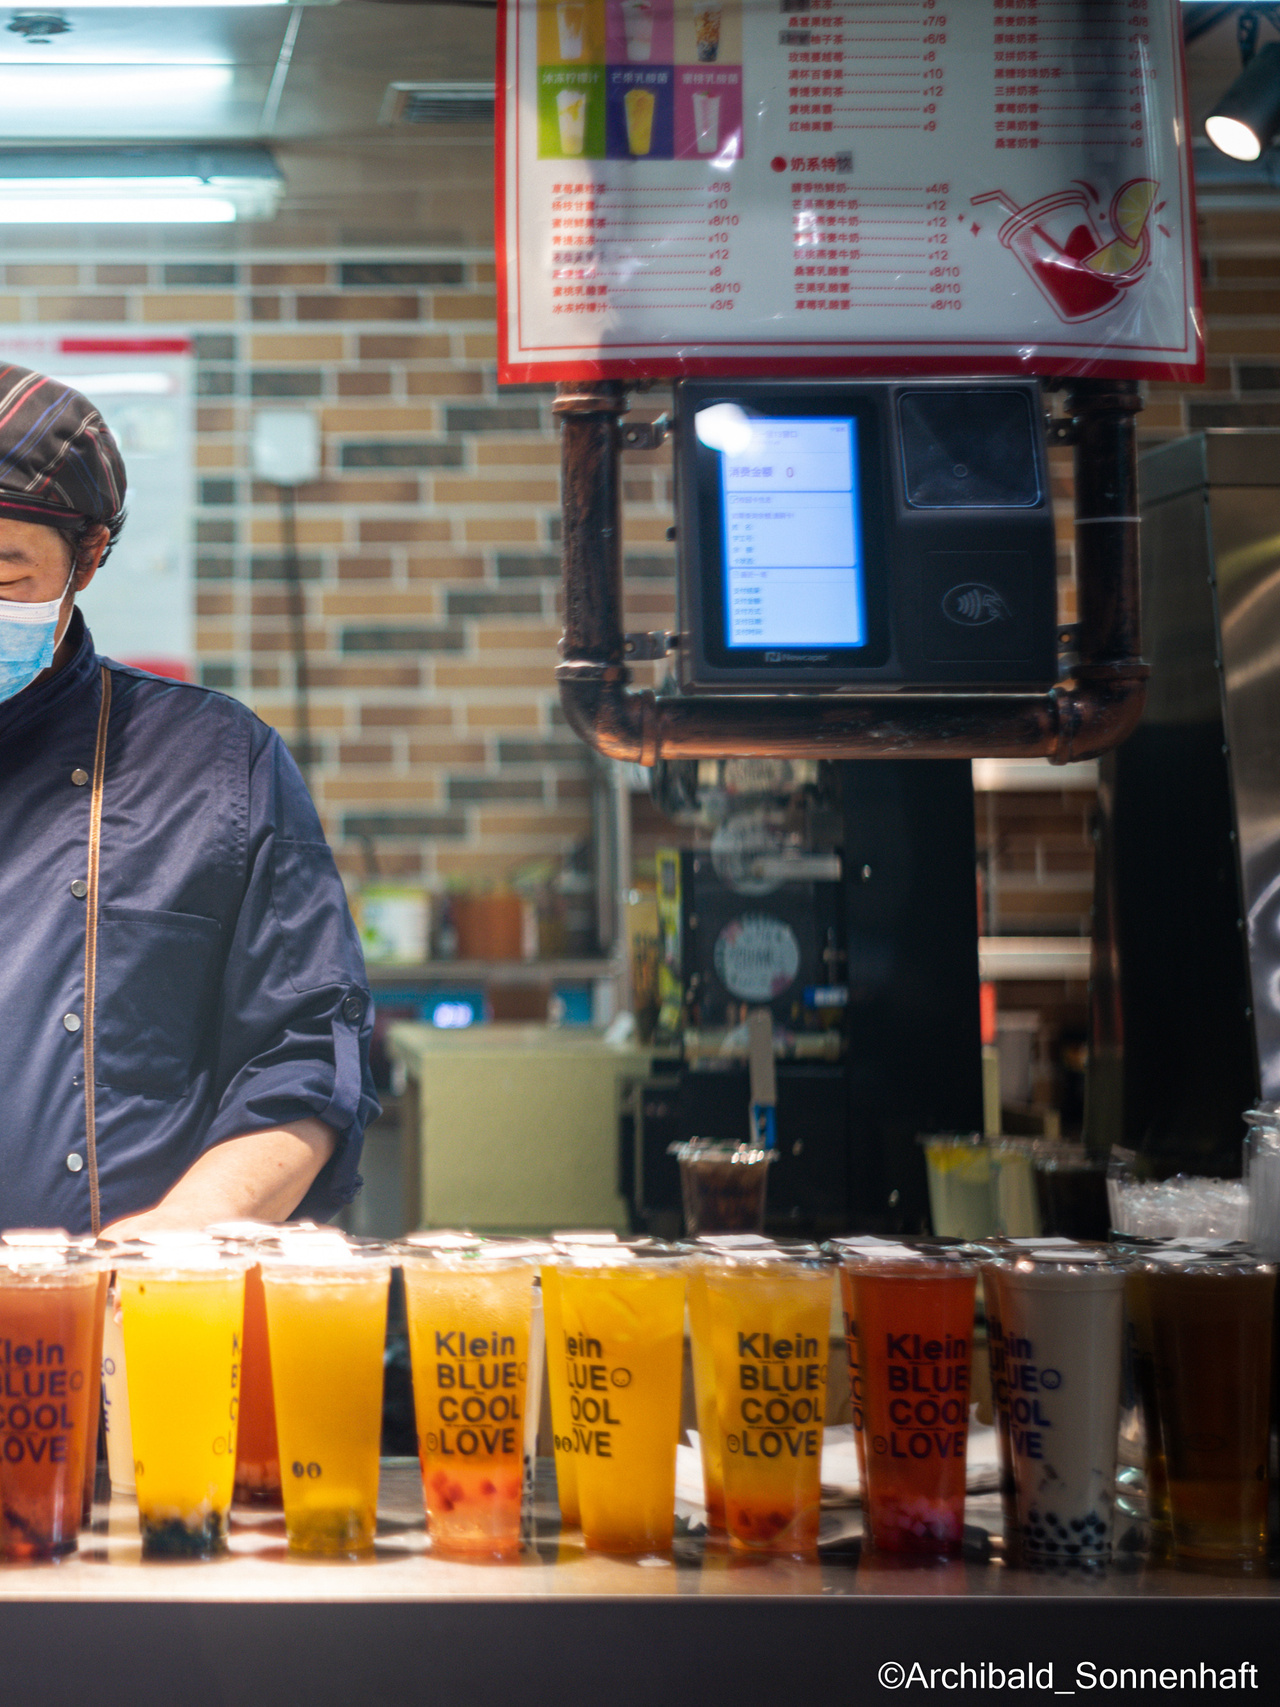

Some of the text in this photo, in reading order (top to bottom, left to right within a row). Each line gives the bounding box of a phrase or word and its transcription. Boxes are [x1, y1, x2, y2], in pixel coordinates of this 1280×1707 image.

[792, 215, 860, 227] 燕麦牛奶
[786, 466, 794, 478] 0
[435, 1330, 515, 1358] Klein
[737, 1331, 818, 1359] Klein
[886, 1333, 967, 1360] Klein
[437, 1362, 517, 1389] BLUE
[567, 1362, 608, 1391] LUE
[739, 1364, 819, 1391] BLUE
[888, 1365, 968, 1393] BLUE
[438, 1394, 521, 1423] COOL
[570, 1394, 621, 1425] OOL
[740, 1397, 822, 1425] COOL
[889, 1398, 968, 1426] COOL
[1011, 1397, 1051, 1426] OL
[440, 1427, 515, 1455] LOVE
[573, 1427, 612, 1457] OVE
[742, 1430, 818, 1458] LOVE
[890, 1431, 966, 1459] LOVE
